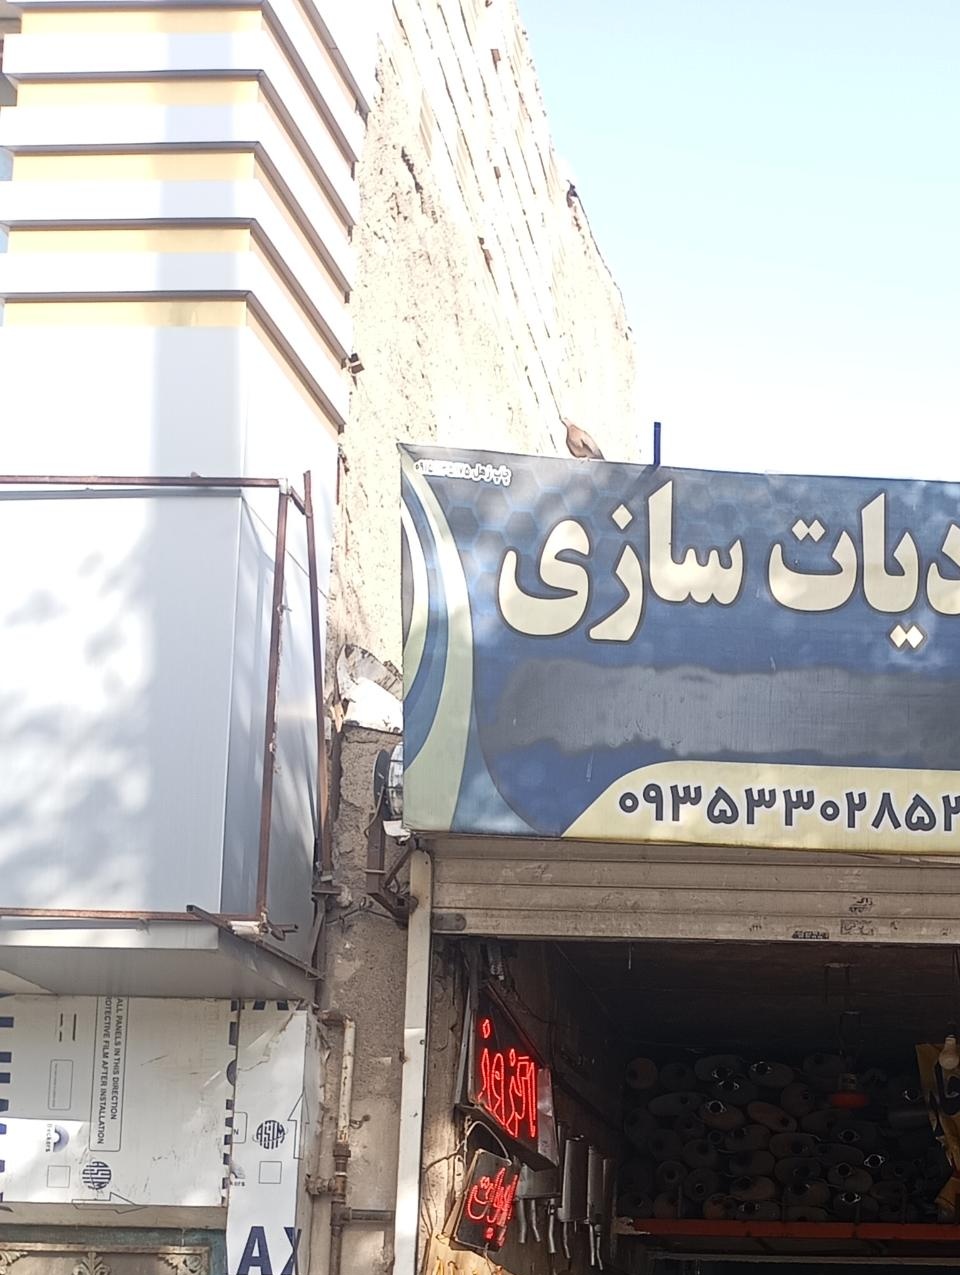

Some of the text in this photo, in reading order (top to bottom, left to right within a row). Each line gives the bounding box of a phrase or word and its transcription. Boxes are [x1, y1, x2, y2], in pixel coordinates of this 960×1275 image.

[497, 480, 744, 643] سازی
[114, 1015, 122, 1046] PANELS
[97, 996, 112, 1145] ROTECTIVE FILM AFTER INSTALLATION
[112, 1058, 120, 1075] THIS
[113, 1048, 121, 1056] IN
[110, 1077, 119, 1120] DIRECTION
